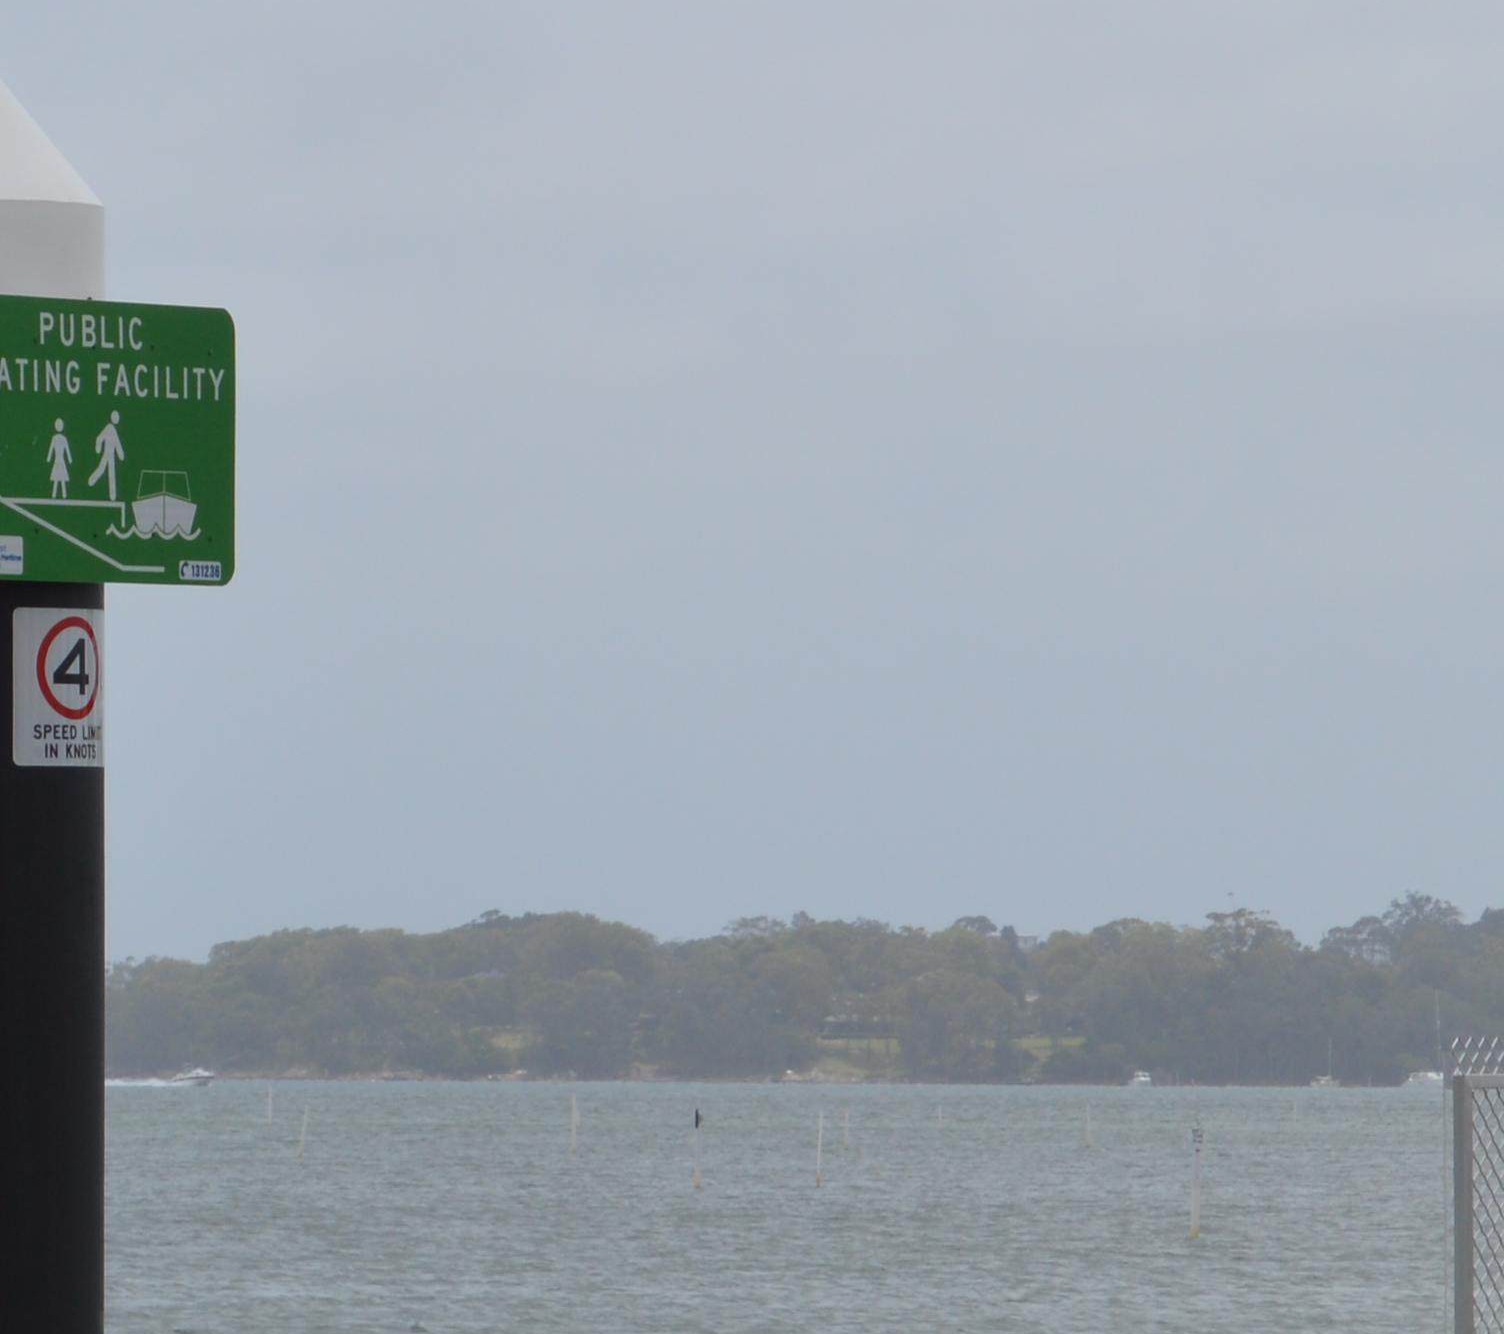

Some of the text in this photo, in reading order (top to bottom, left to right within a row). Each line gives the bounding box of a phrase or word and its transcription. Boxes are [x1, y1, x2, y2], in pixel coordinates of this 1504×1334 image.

[39, 311, 143, 351] PUBLIC
[96, 362, 225, 401] FACILITY
[190, 564, 221, 579] 131236
[53, 638, 89, 696] 4
[33, 724, 77, 740] SPEED
[44, 743, 97, 759] IN KNOTS
